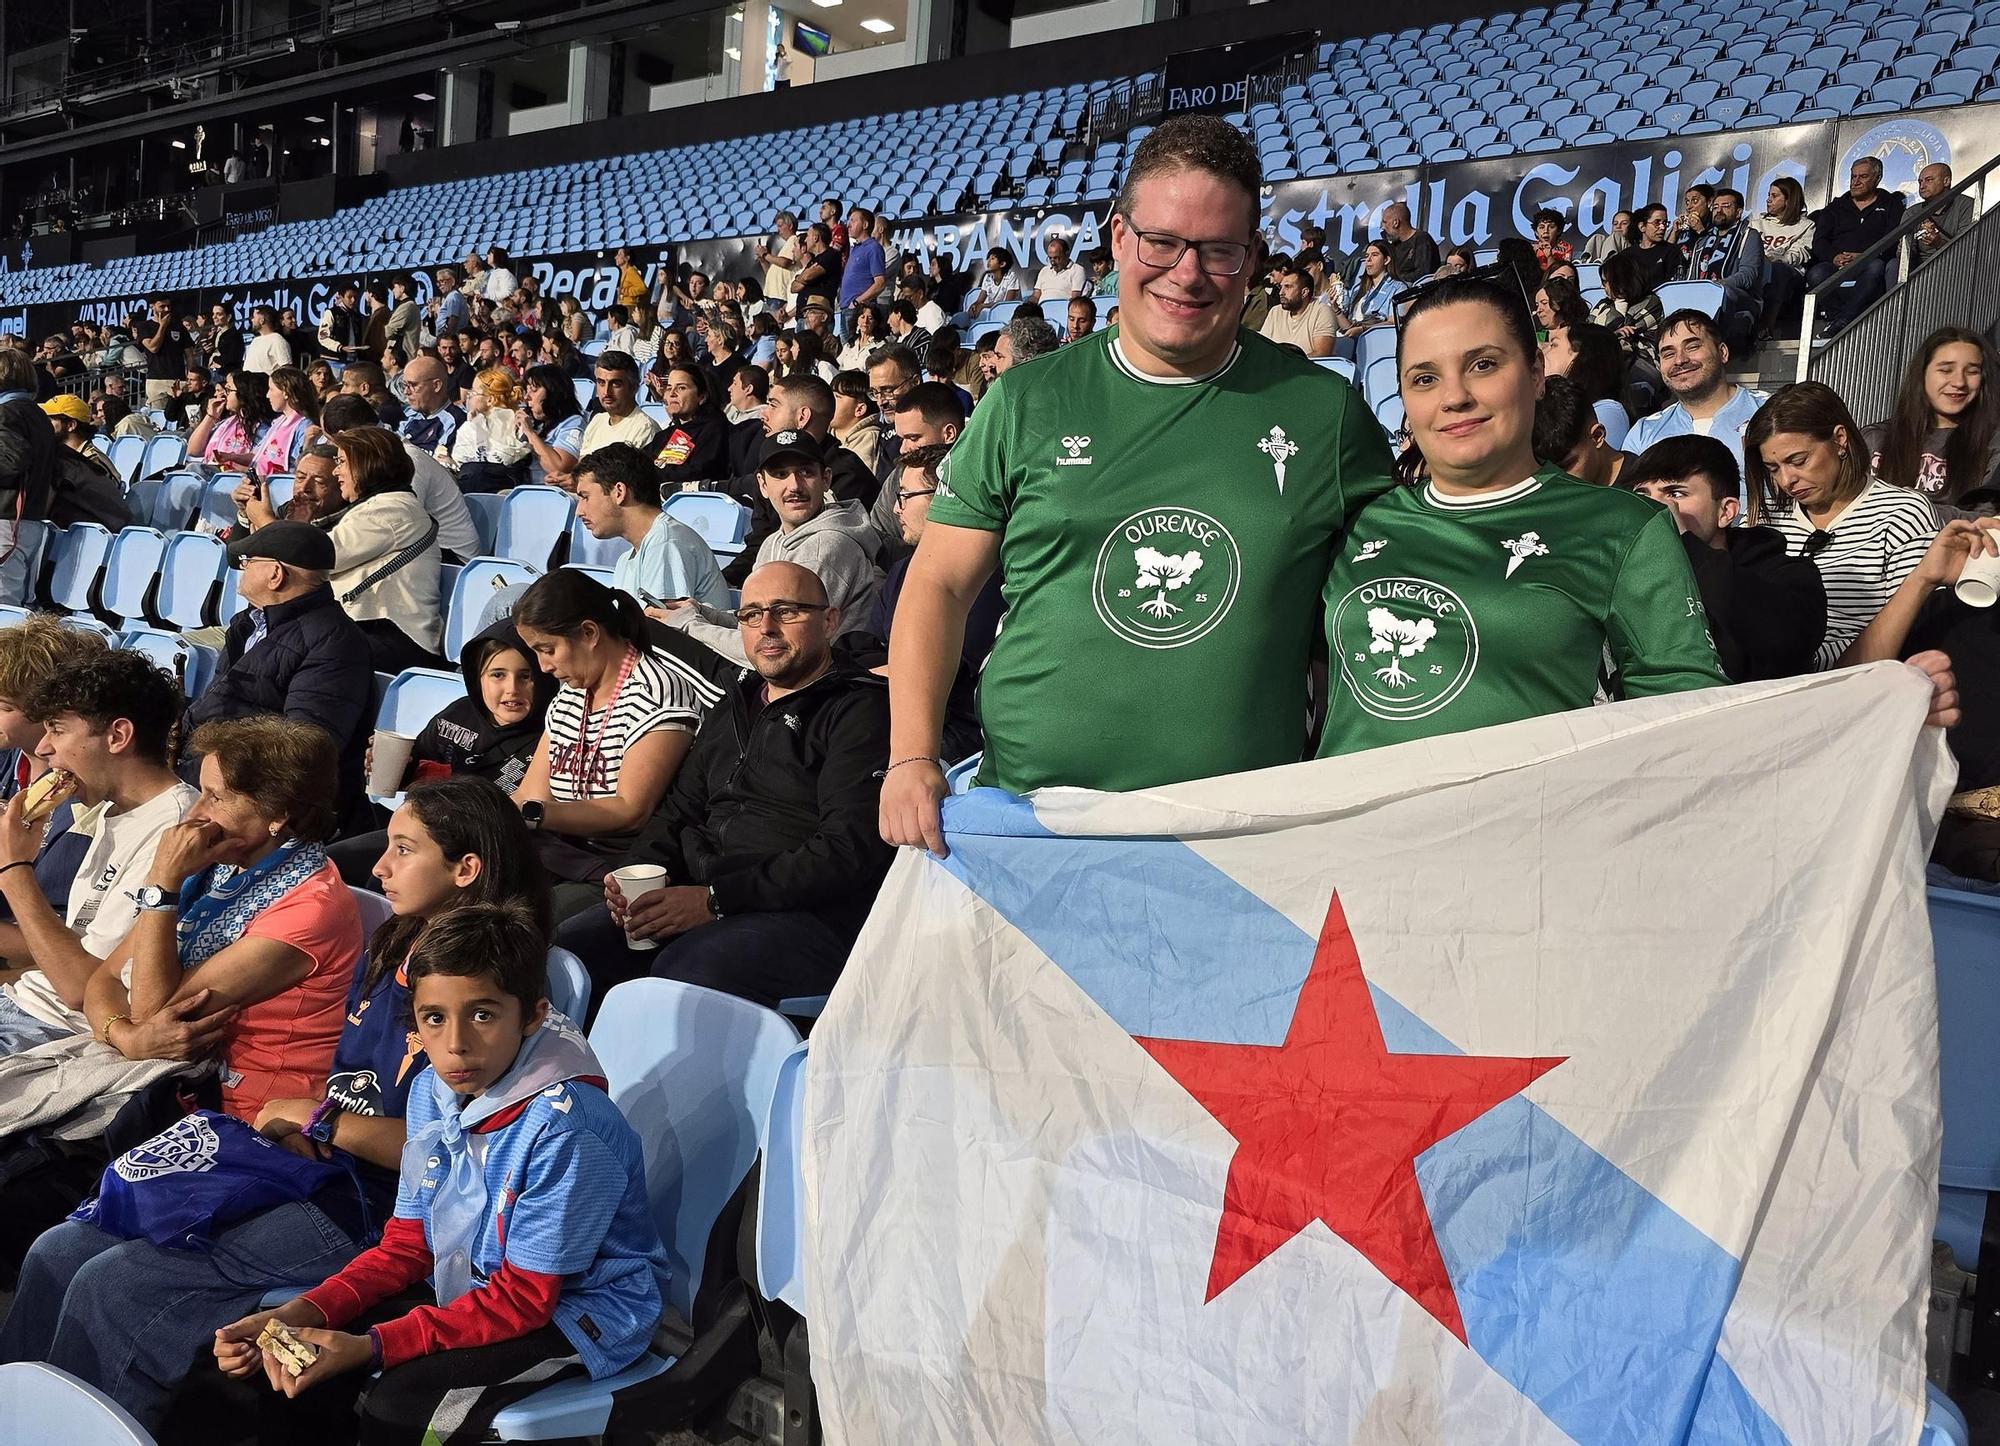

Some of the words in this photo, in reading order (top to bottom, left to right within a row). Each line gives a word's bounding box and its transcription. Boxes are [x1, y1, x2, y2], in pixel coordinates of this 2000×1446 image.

[1168, 85, 1216, 111] FARO
[1220, 80, 1247, 103] DE
[532, 250, 669, 311] Recavi
[1056, 455, 1093, 467] hummel
[1125, 514, 1221, 548] OURENSE
[1117, 588, 1131, 599] 20
[1195, 593, 1208, 603] 25
[1359, 581, 1457, 618] OURENSE
[1354, 652, 1366, 663] 20
[1428, 664, 1443, 675] 25
